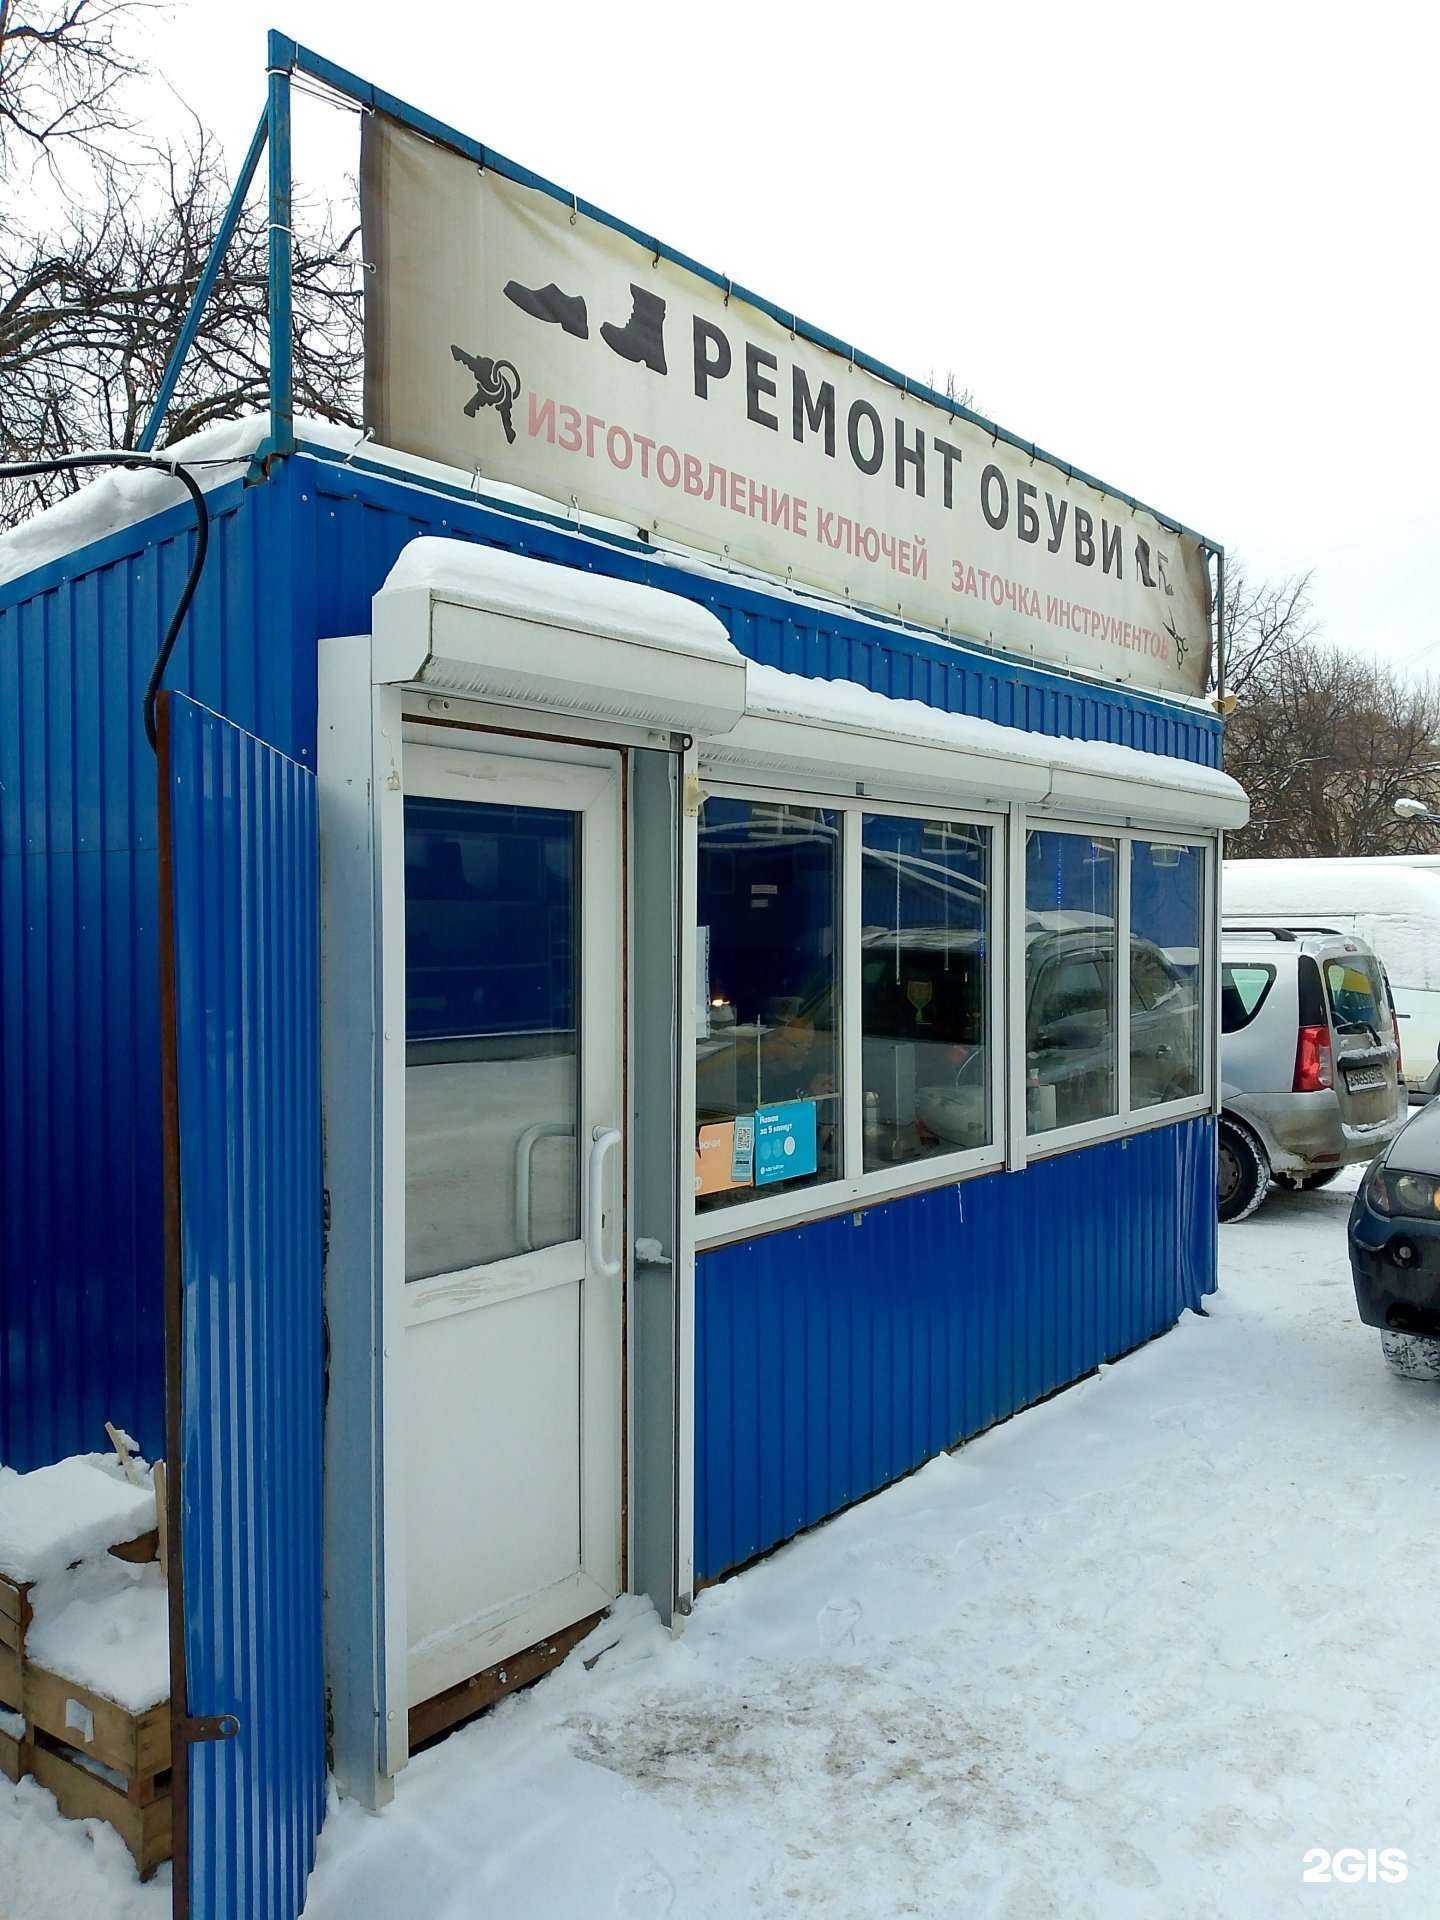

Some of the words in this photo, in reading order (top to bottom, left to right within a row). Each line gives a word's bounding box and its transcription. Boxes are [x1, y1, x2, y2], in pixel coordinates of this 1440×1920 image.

[527, 391, 808, 537] ИЗГОТОВЛЕНИЕ
[816, 506, 928, 581] КЛЮЧЕЙ
[693, 314, 962, 510] РЕМОНТ
[980, 463, 1123, 580] ОБУВИ
[951, 559, 1042, 620] ЗАТОЧКА
[1046, 594, 1169, 660] ИНСТРУМЕНТОВ
